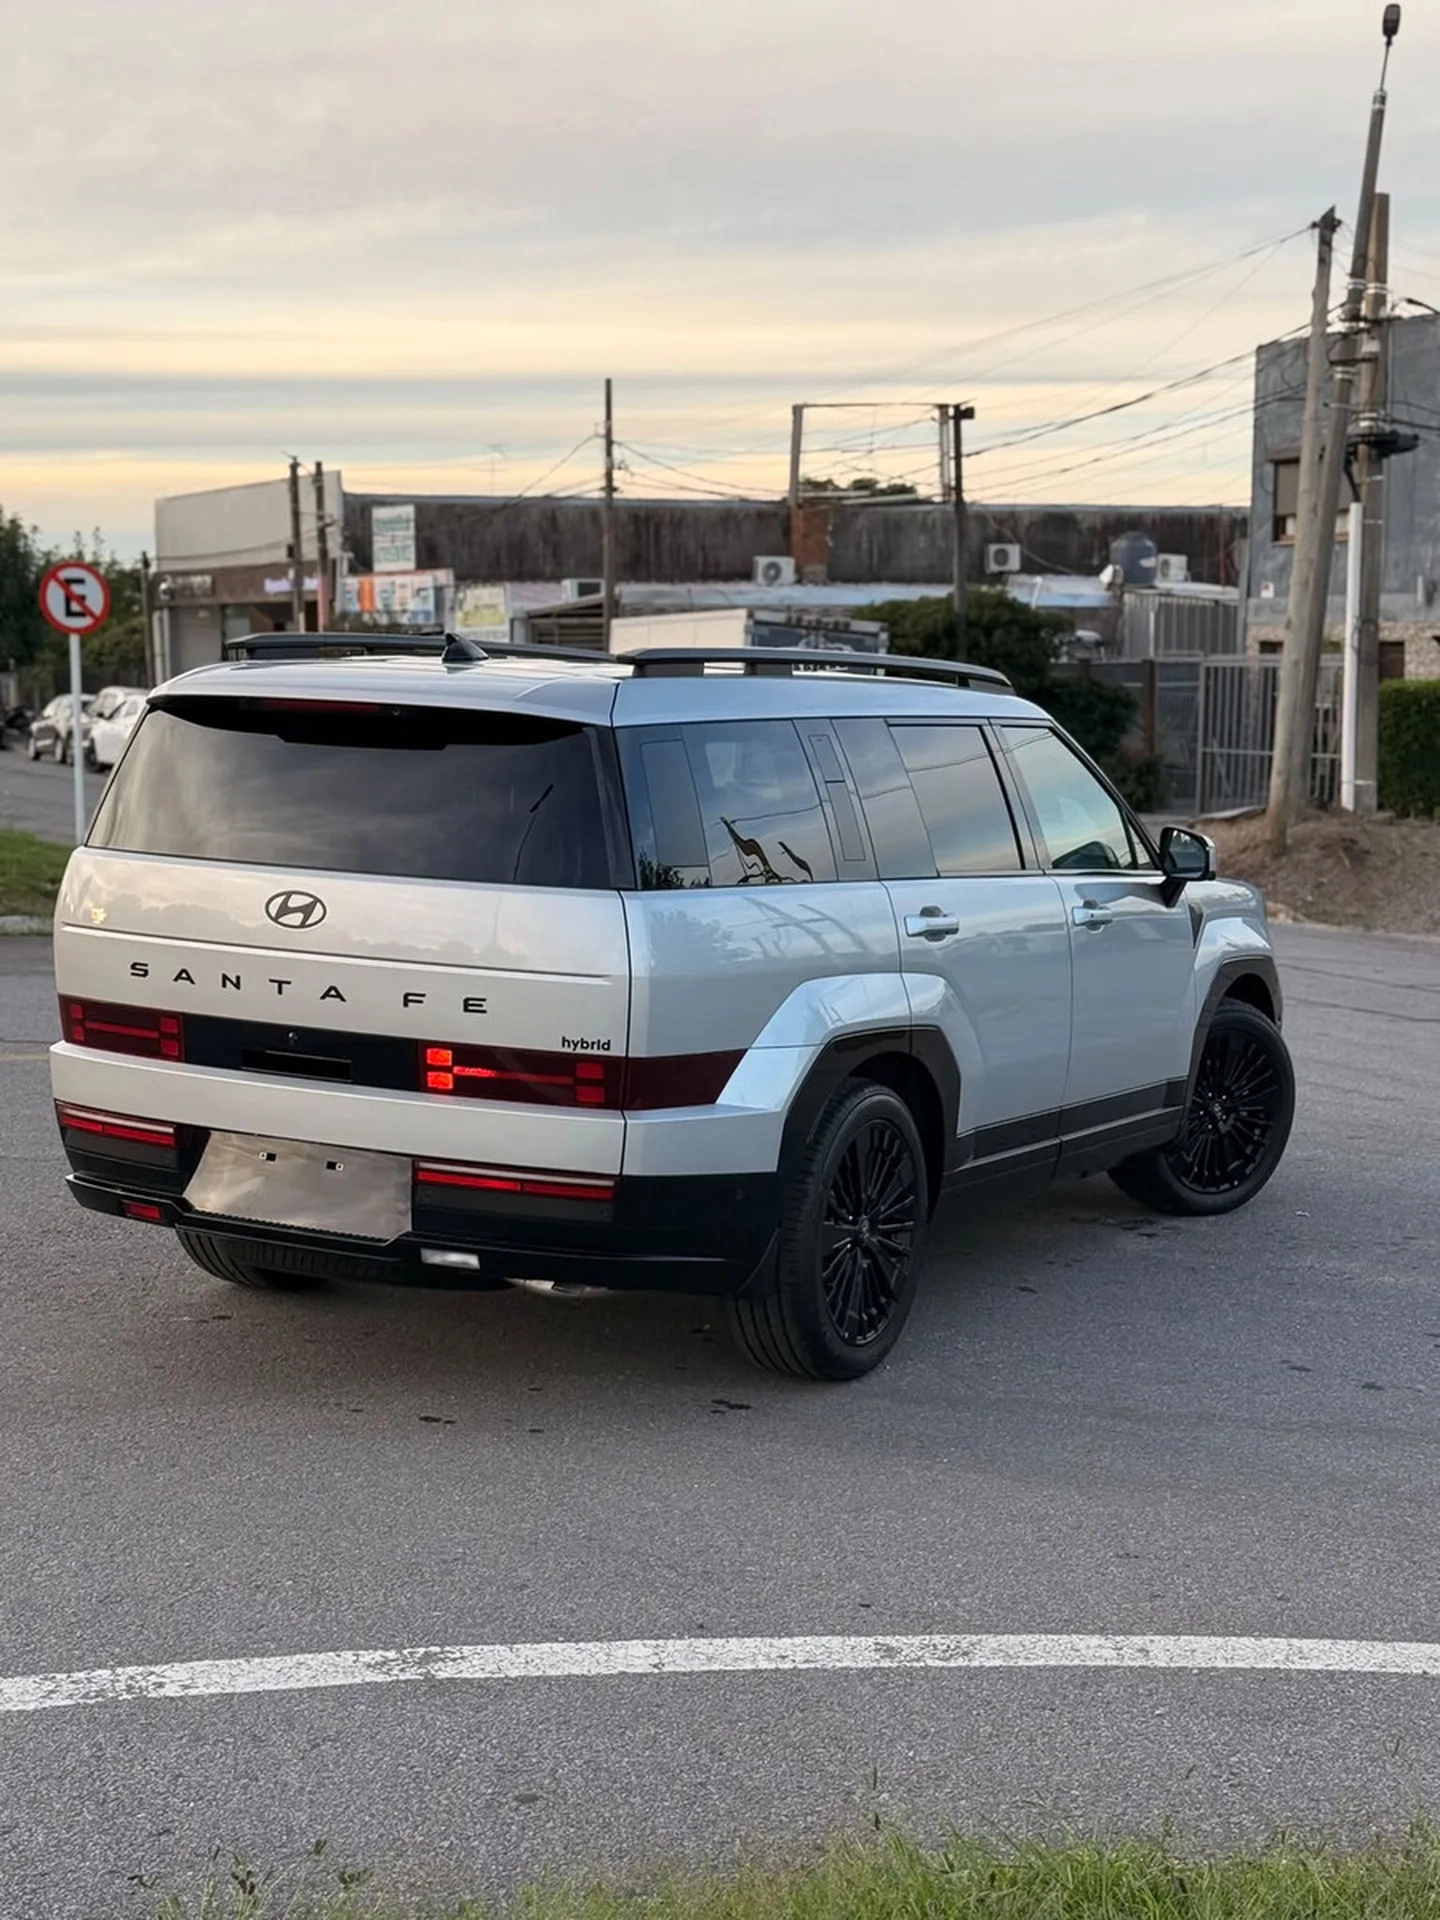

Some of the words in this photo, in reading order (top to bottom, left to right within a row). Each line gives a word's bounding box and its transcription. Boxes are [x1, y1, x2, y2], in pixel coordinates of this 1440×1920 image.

[64, 577, 87, 618] E
[130, 961, 347, 1003] SANTA
[402, 992, 488, 1015] FE
[562, 1036, 611, 1052] hybrid
